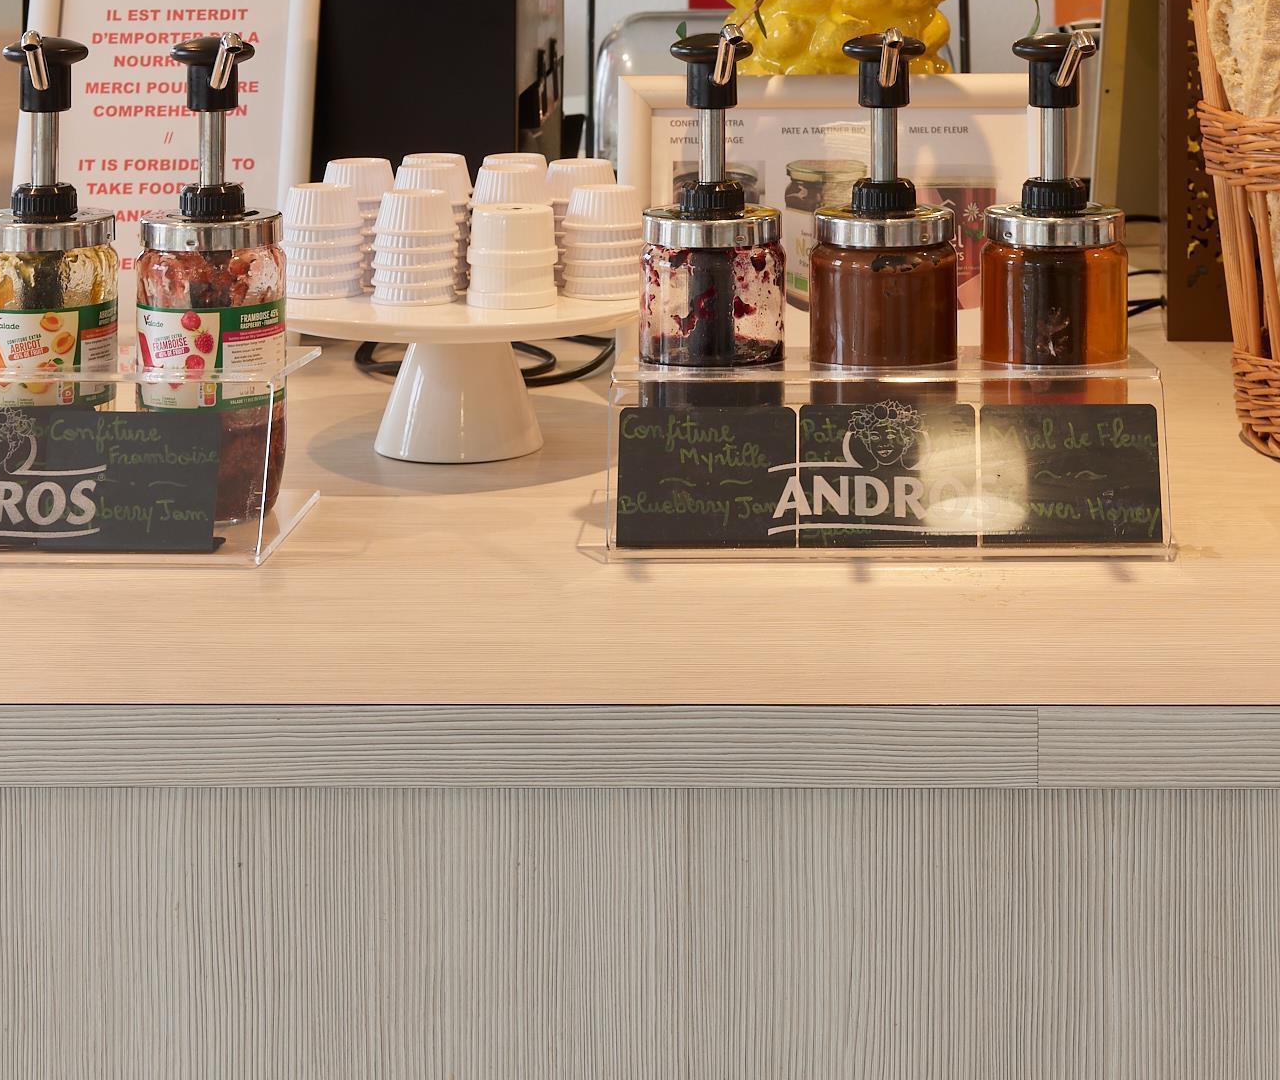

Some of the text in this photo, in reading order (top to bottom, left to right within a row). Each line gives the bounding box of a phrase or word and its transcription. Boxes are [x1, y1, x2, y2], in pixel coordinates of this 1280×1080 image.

[105, 9, 249, 21] IL EST INTERDIT
[85, 82, 188, 94] MERCI POU
[93, 105, 248, 117] COMPREHEN
[670, 119, 744, 127] CONFIT XTRA
[908, 126, 969, 134] MIEL DE FLEUR
[670, 136, 699, 144] MYTILL
[78, 158, 256, 171] IT IS FORBIDD TO
[86, 183, 133, 195] TAKE
[143, 314, 164, 328] Valade
[240, 310, 270, 323] FRAMBOISE
[240, 321, 262, 330] RASPBERRY
[10, 338, 41, 354] ABRICOT
[152, 336, 188, 352] FRAMBOISE
[49, 415, 162, 452] Confiture
[622, 413, 736, 452] Confiture
[1063, 422, 1093, 450] de
[108, 444, 220, 466] Framboise
[679, 442, 770, 473] Myrtille
[155, 499, 209, 521] Jam
[619, 489, 730, 527] Blueberry
[1086, 496, 1160, 538] Honey
